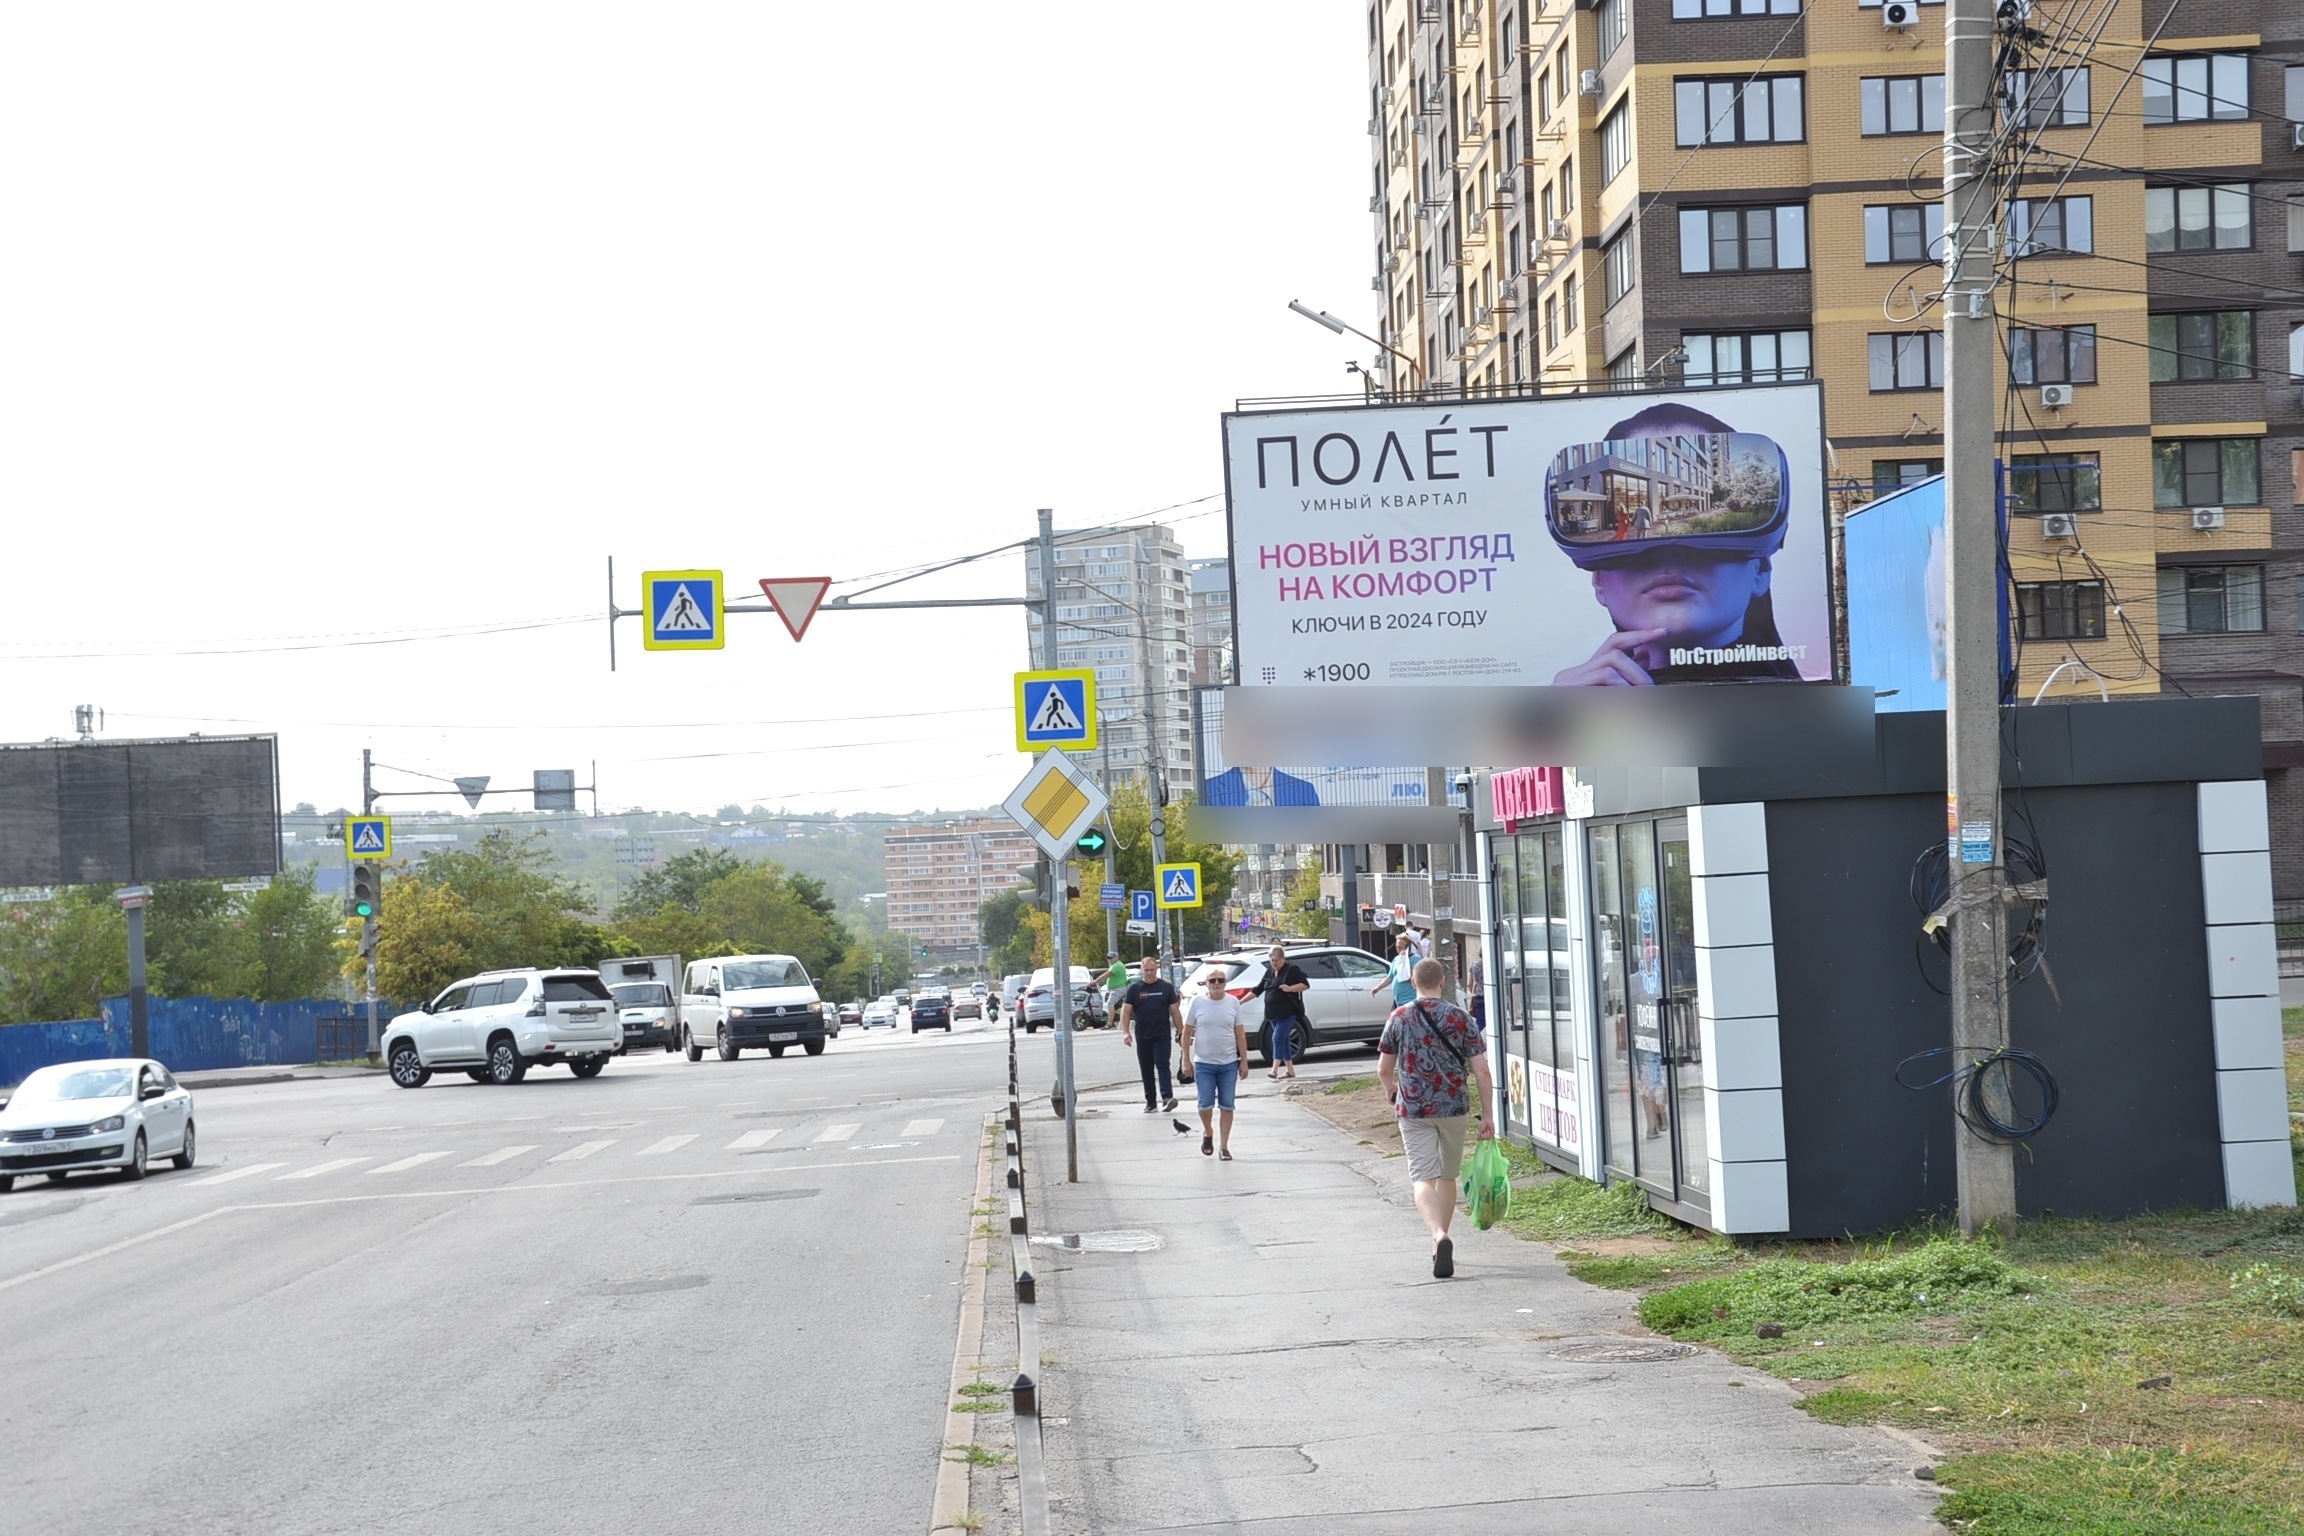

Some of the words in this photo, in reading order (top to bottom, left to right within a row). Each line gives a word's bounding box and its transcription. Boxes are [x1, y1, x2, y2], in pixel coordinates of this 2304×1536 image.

[1301, 493, 1372, 512] УМНЫЙ
[1381, 491, 1468, 509] КВАРТАЛ
[1259, 533, 1381, 570] НОВЫЙ
[1389, 533, 1515, 564] ВЗГЛЯД
[1278, 575, 1325, 602] НА
[1332, 567, 1498, 600] КОМФОРТ
[1291, 614, 1365, 634] КЛЮЧИ
[1369, 614, 1382, 631] В
[1386, 612, 1433, 630] 2024
[1437, 609, 1488, 629] ГОДУ
[1669, 643, 1808, 667] ЮгСтройИнвест
[1490, 767, 1554, 834] ЦВЕТЫ
